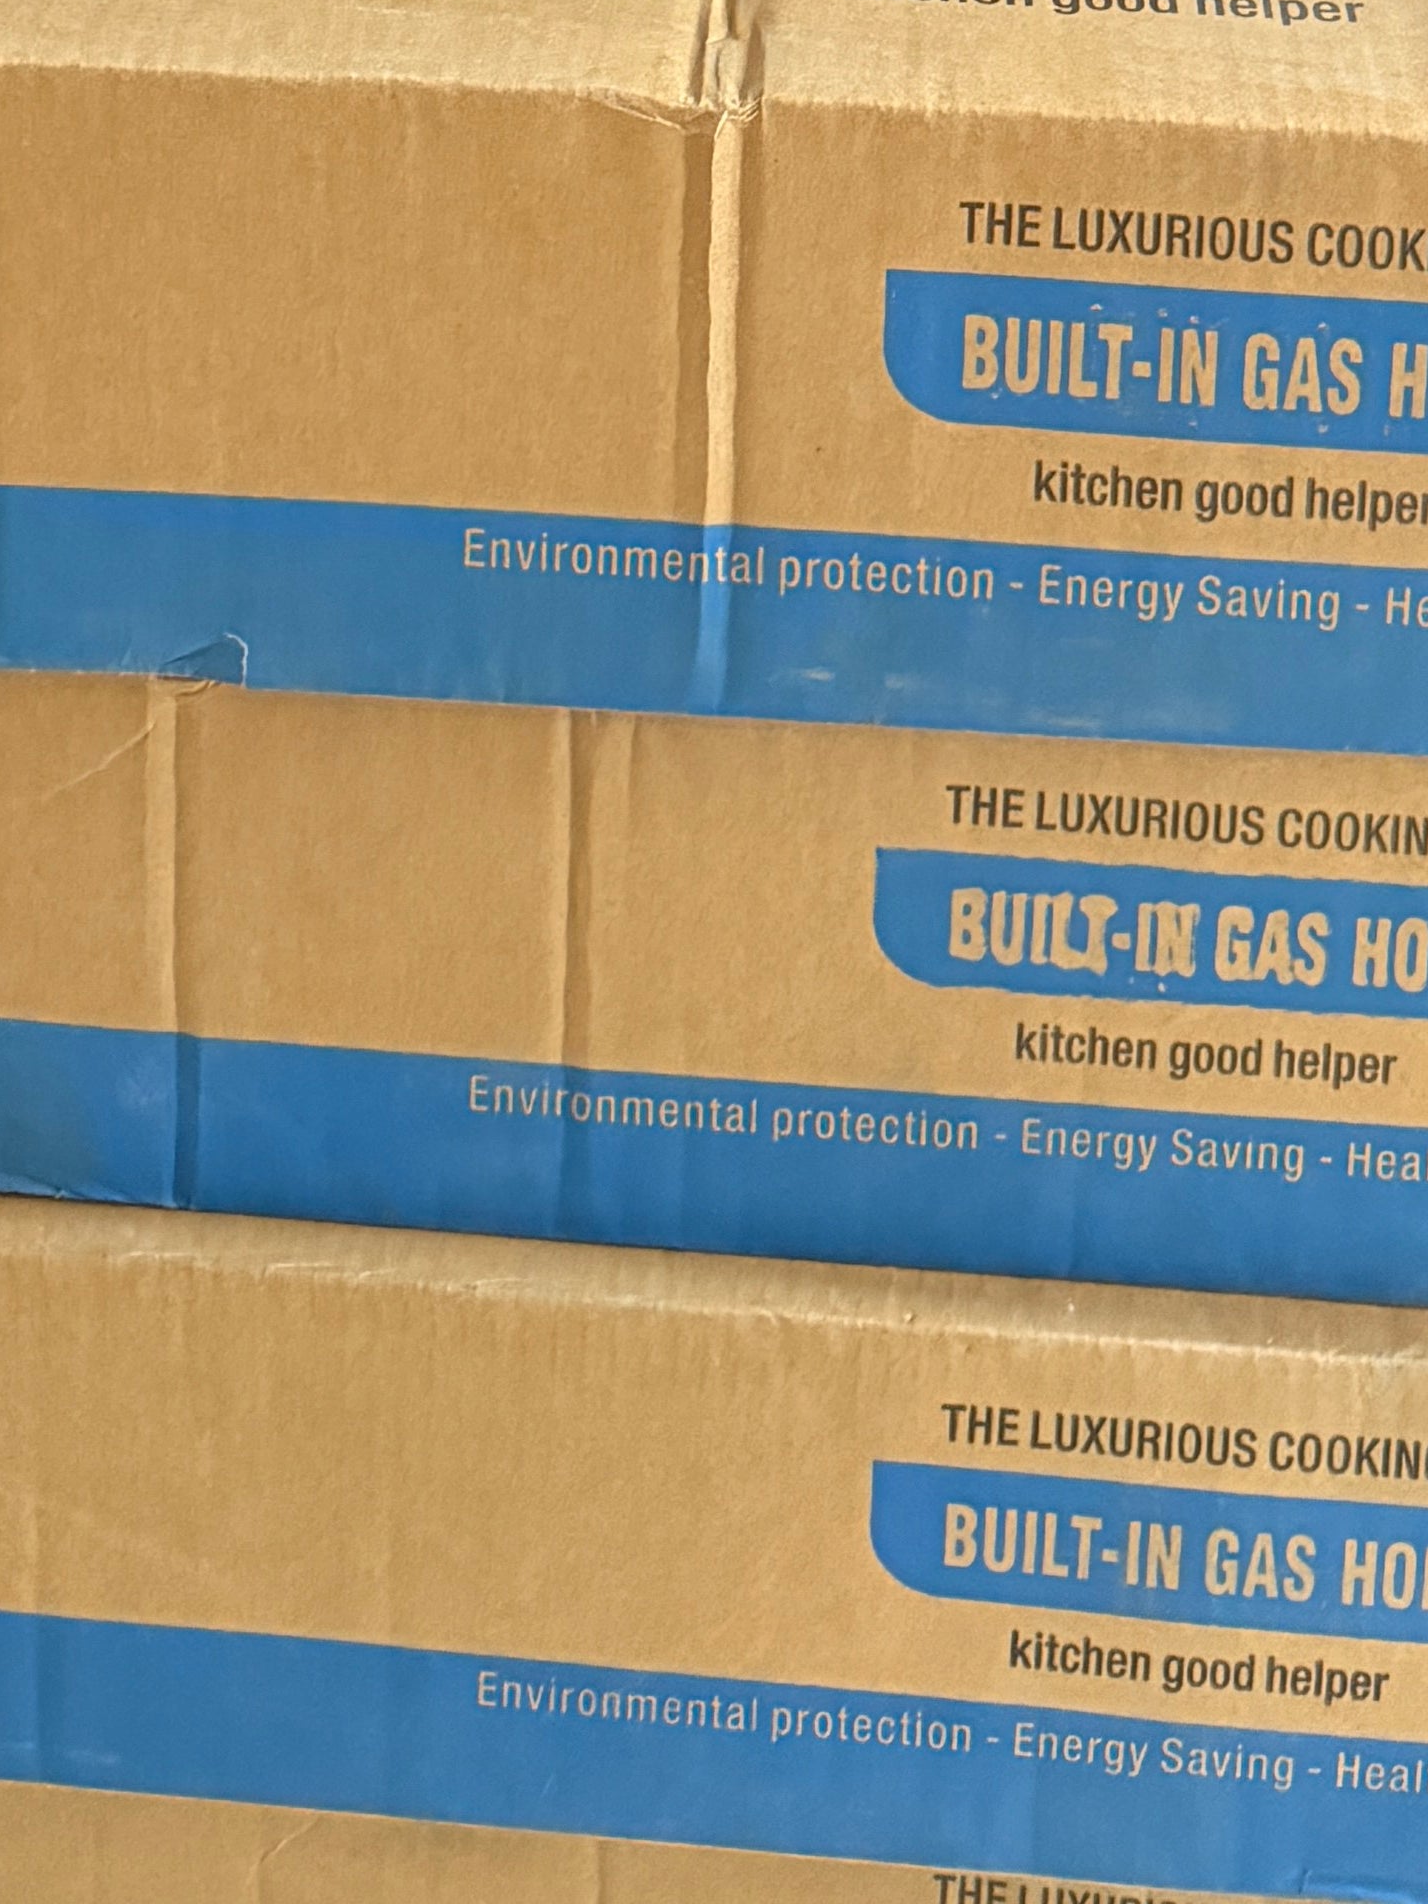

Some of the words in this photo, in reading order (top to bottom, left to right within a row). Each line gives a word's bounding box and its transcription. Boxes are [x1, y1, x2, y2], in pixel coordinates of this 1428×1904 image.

[958, 199, 1042, 251] THE
[1051, 204, 1295, 266] LUXURIOUS
[960, 311, 1219, 408] BUILT-IN
[1242, 329, 1363, 417] GAS
[1031, 459, 1184, 515] kitchen
[1192, 469, 1295, 525] good
[462, 527, 766, 588] Environmental
[777, 546, 995, 603] protection
[1036, 562, 1184, 623] Energy
[1196, 574, 1342, 633] Saving
[944, 783, 1025, 830] THE
[1033, 790, 1267, 846] LUXURIOUS
[948, 886, 1201, 978] BUILT-IN
[1214, 904, 1333, 988] GAS
[1014, 1020, 1158, 1073] kitchen
[1169, 1034, 1264, 1081] good
[1271, 1039, 1398, 1091] helper
[468, 1073, 759, 1135] Environmental
[771, 1103, 980, 1150] protection
[1020, 1115, 1158, 1173] Energy
[1168, 1126, 1306, 1181] Saving
[940, 1402, 1021, 1449] THE
[1029, 1411, 1259, 1468] LUXURIOUS
[941, 1501, 1182, 1592] BUILT-IN
[1202, 1524, 1318, 1604] GAS
[1007, 1628, 1152, 1684] kitchen
[1161, 1646, 1257, 1695] good
[1263, 1654, 1391, 1705] helper
[475, 1668, 760, 1734] Environmental
[769, 1698, 973, 1754] protection
[1010, 1719, 1149, 1780] Energy
[1159, 1734, 1295, 1791] Saving
[933, 1873, 1008, 1904] THE
